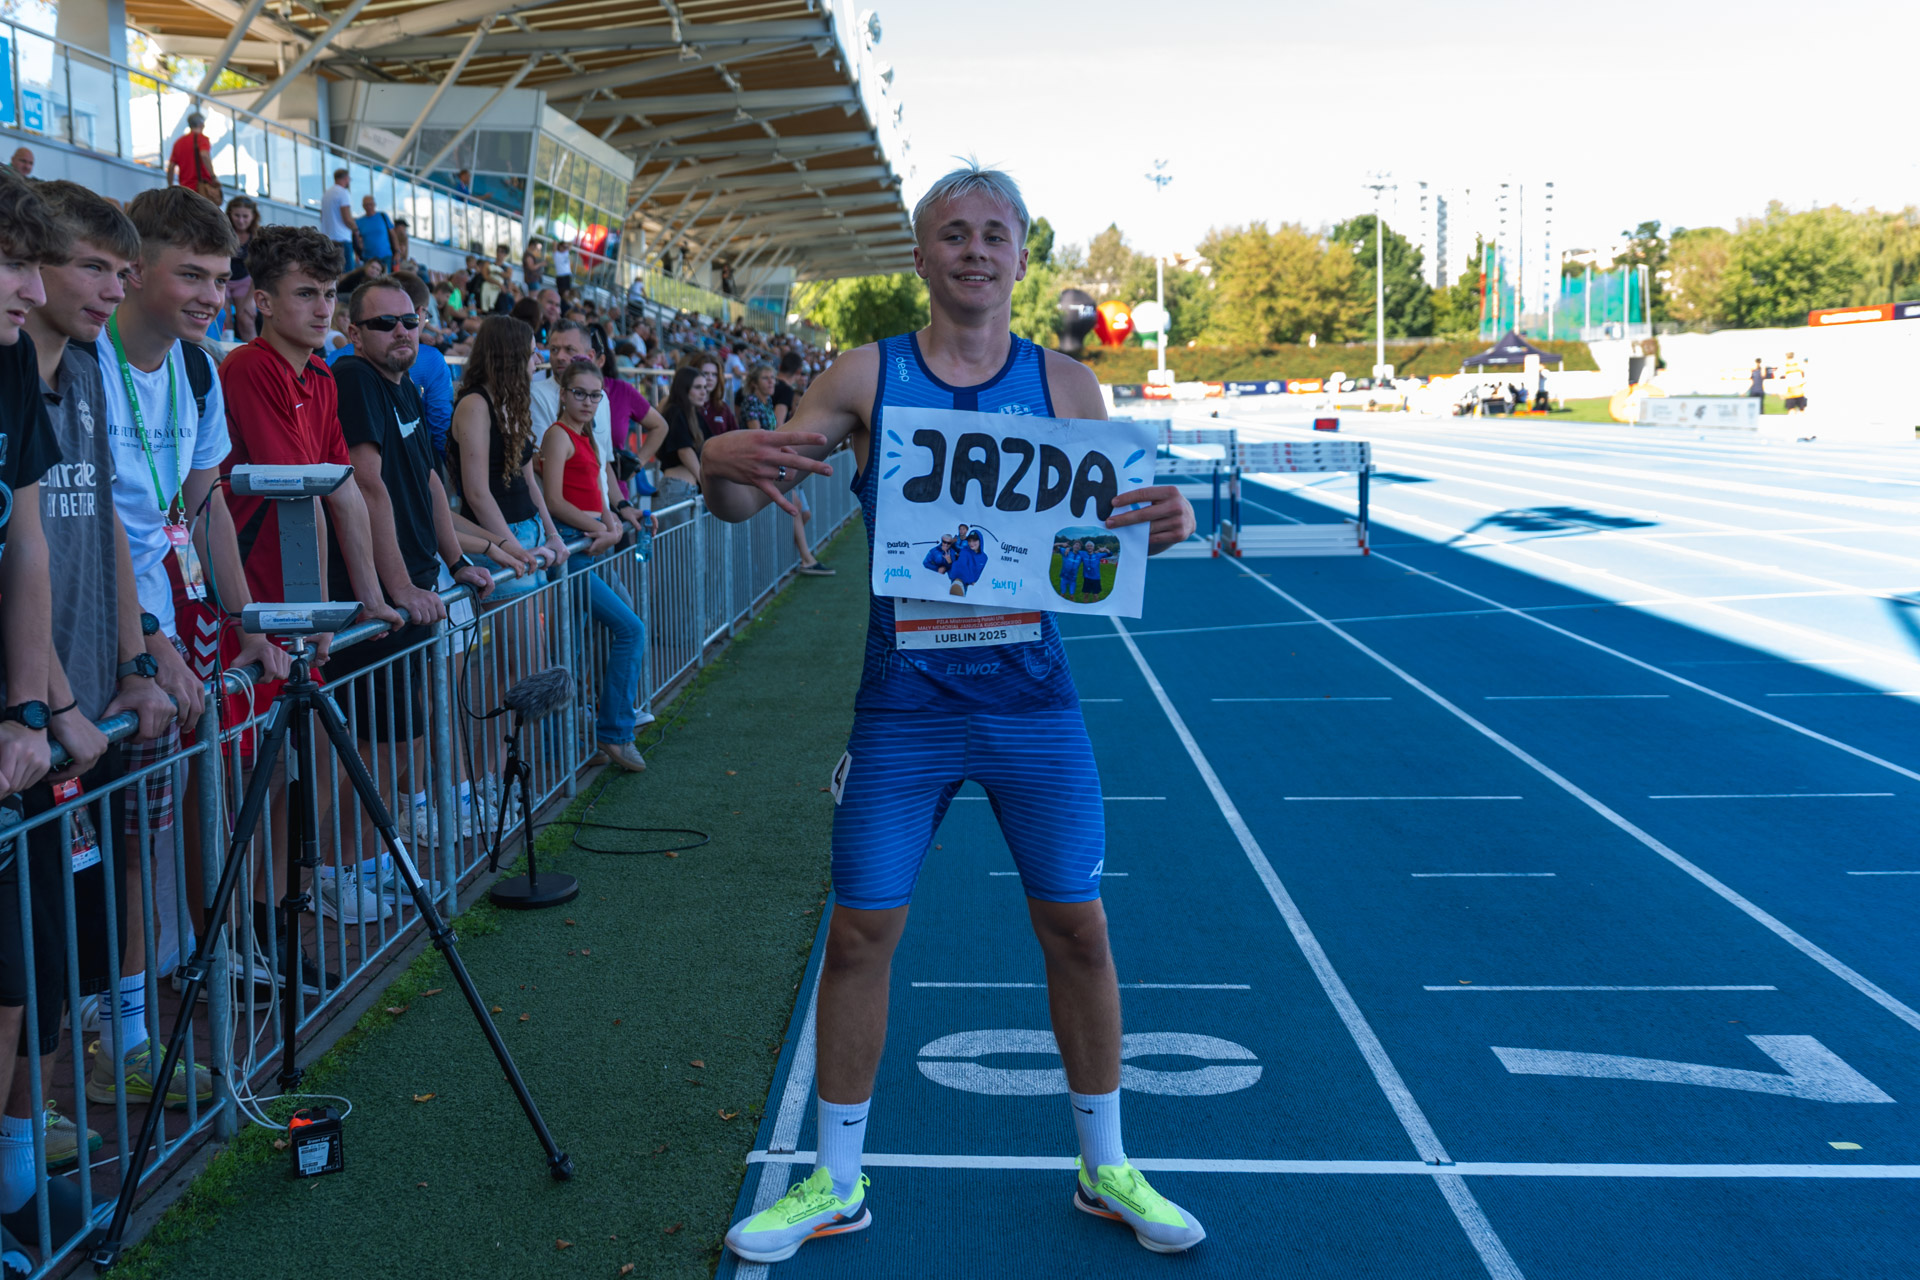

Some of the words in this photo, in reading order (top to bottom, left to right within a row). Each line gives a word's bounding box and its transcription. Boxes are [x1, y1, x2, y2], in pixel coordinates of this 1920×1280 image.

[896, 356, 910, 382] deep
[154, 428, 162, 439] IS
[902, 429, 1118, 521] JAZDA
[935, 633, 976, 643] LUBLIN
[979, 630, 1007, 641] 2025
[946, 662, 1000, 675] ELWOZ
[1490, 1034, 1898, 1104] 7
